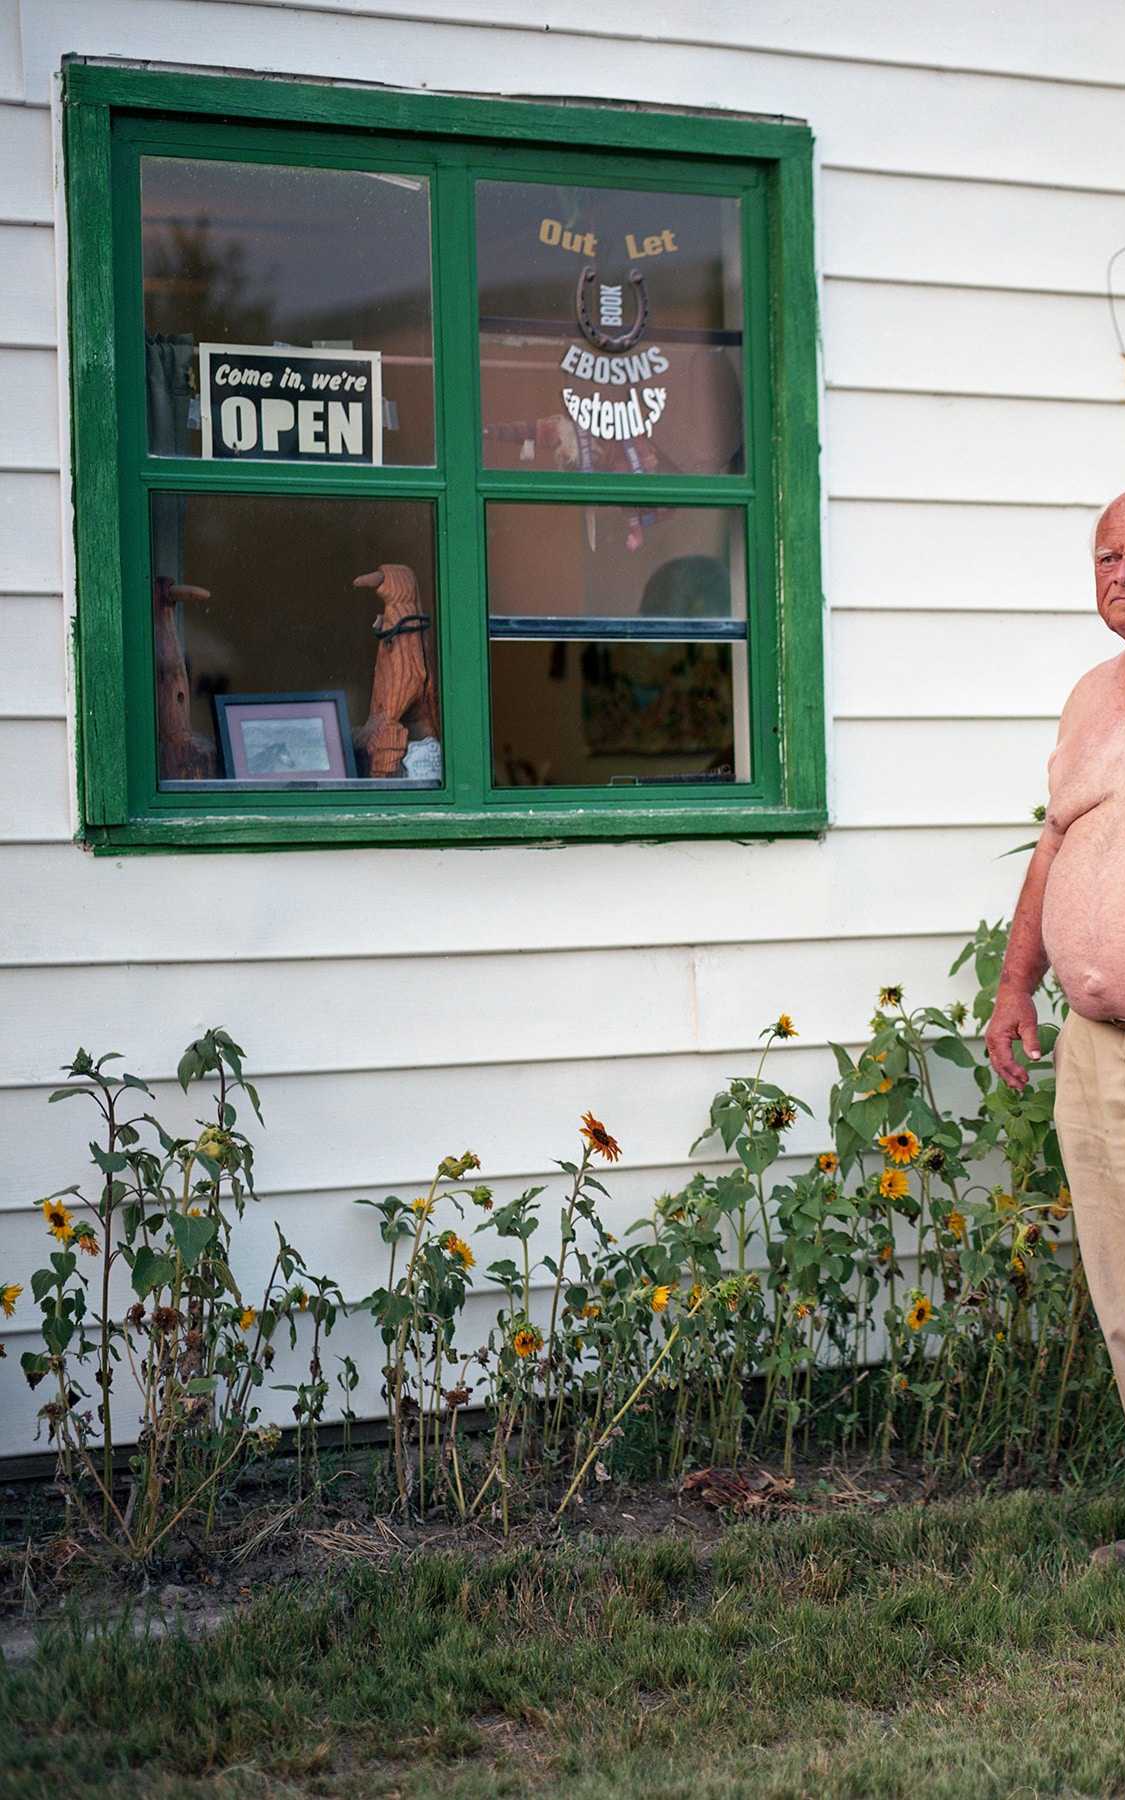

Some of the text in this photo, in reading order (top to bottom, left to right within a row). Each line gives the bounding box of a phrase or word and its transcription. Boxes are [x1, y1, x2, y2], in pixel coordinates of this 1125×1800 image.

[539, 218, 679, 260] Out Let
[600, 284, 623, 327] BOOK
[215, 364, 368, 392] Come in, we're
[560, 345, 670, 385] EBOSWS
[220, 396, 363, 455] OPEN
